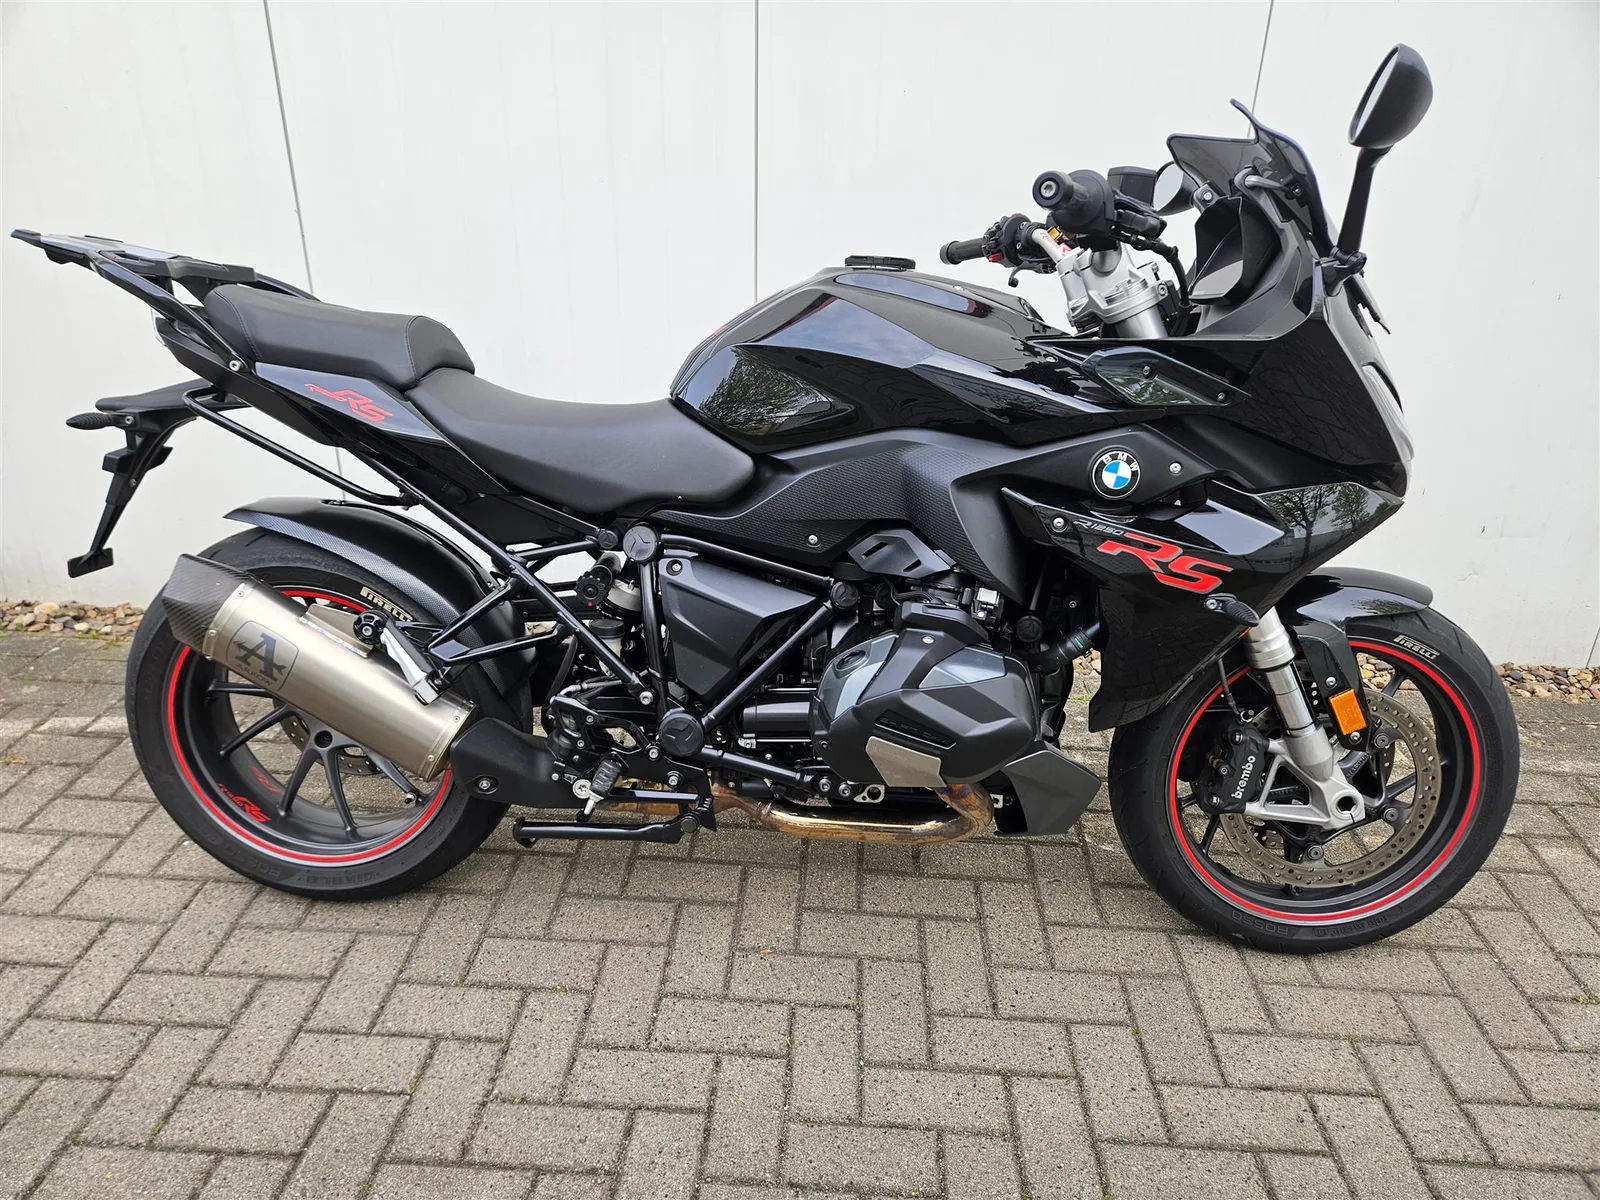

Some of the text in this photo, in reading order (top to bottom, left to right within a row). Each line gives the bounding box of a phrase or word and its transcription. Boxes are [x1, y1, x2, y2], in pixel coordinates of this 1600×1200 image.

[1102, 452, 1139, 472] BMW
[1073, 519, 1234, 594] R1250 RS
[1393, 634, 1440, 660] PIRELLI
[1231, 755, 1256, 799] brembo
[1231, 910, 1288, 935] ROSSO
